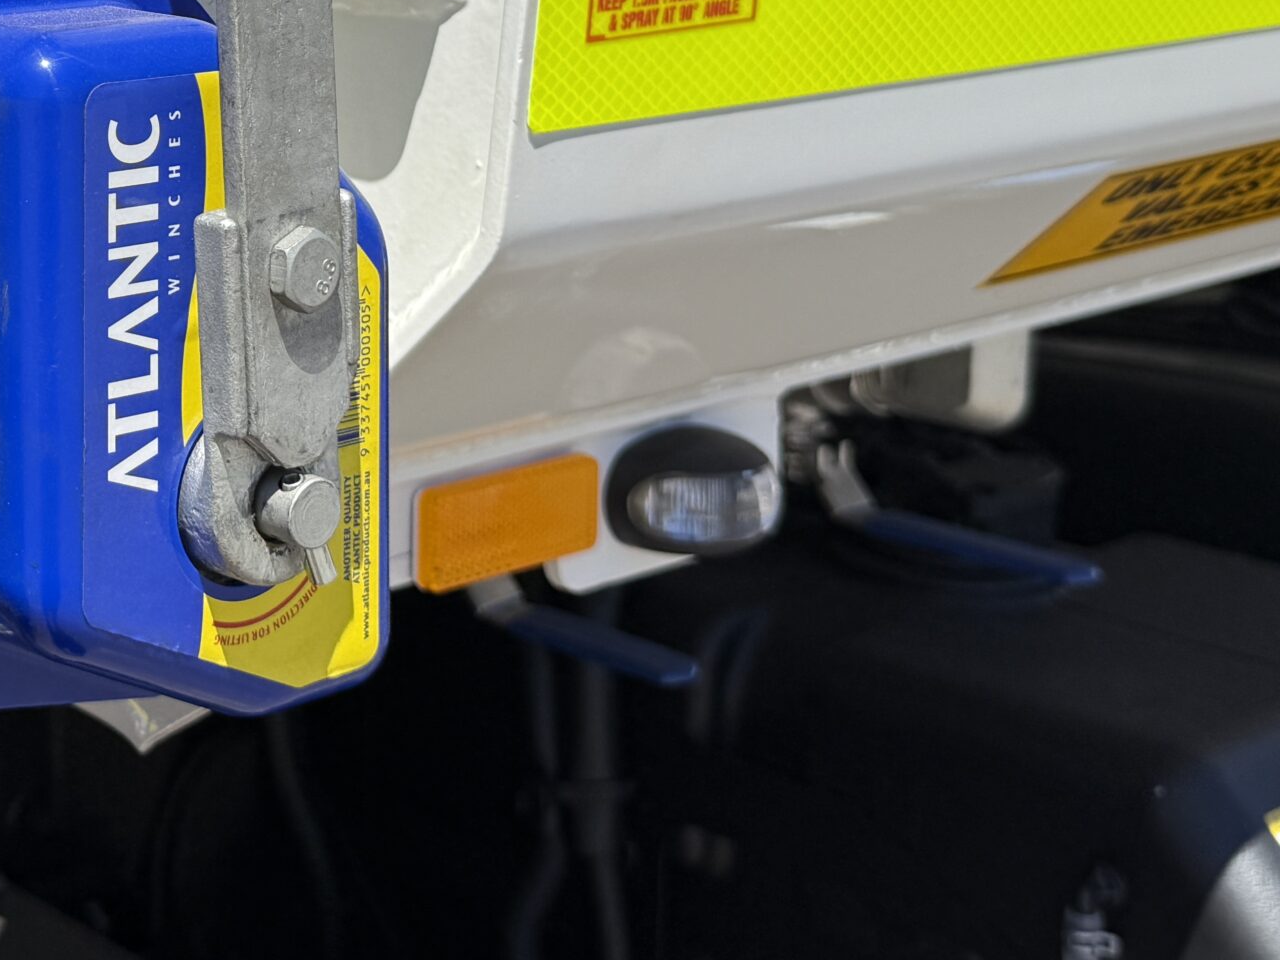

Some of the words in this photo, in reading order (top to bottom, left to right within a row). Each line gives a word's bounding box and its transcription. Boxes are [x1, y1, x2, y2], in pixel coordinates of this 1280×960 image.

[608, 14, 617, 32] &
[621, 8, 659, 30] SPRAY
[662, 7, 676, 24] AT
[168, 109, 182, 295] WINCHES
[107, 113, 160, 493] ATLANTIC
[361, 304, 371, 367] 000305
[360, 374, 371, 435] 337451
[360, 448, 370, 457] 9
[343, 475, 352, 524] QUALITY
[353, 474, 362, 528] PRODUCT
[343, 527, 352, 582] ANOTHER
[352, 529, 362, 584] ATLANTIC
[362, 470, 372, 640] www.atlanticproducts.com.au
[252, 625, 270, 641] FOR
[272, 584, 318, 631] DIRECTION
[214, 632, 249, 646] LIFTING
